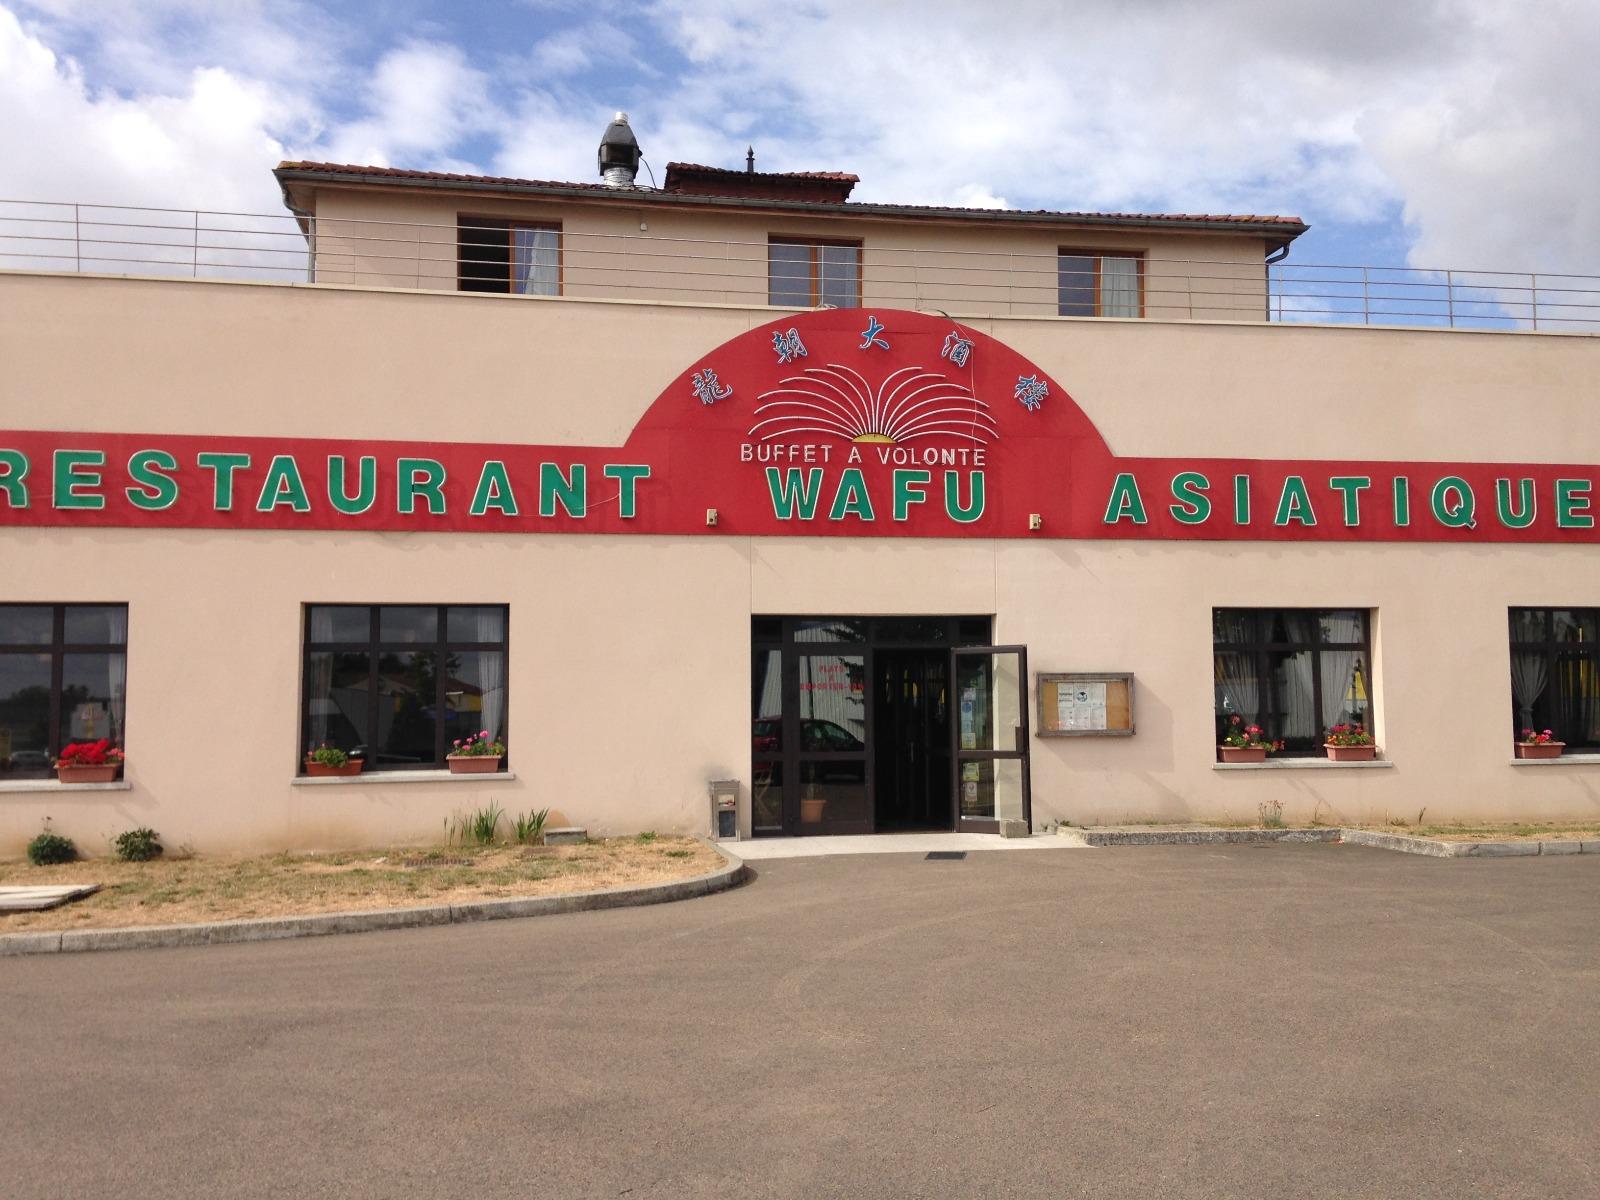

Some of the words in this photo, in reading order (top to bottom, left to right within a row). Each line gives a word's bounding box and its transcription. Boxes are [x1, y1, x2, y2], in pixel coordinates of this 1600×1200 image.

[740, 443, 833, 463] BUFFET
[848, 445, 862, 464] A
[879, 446, 986, 467] VOLONTE
[0, 448, 651, 518] RESTAURANT
[765, 466, 986, 523] WAFU
[1103, 472, 1595, 529] ASIATIQUE
